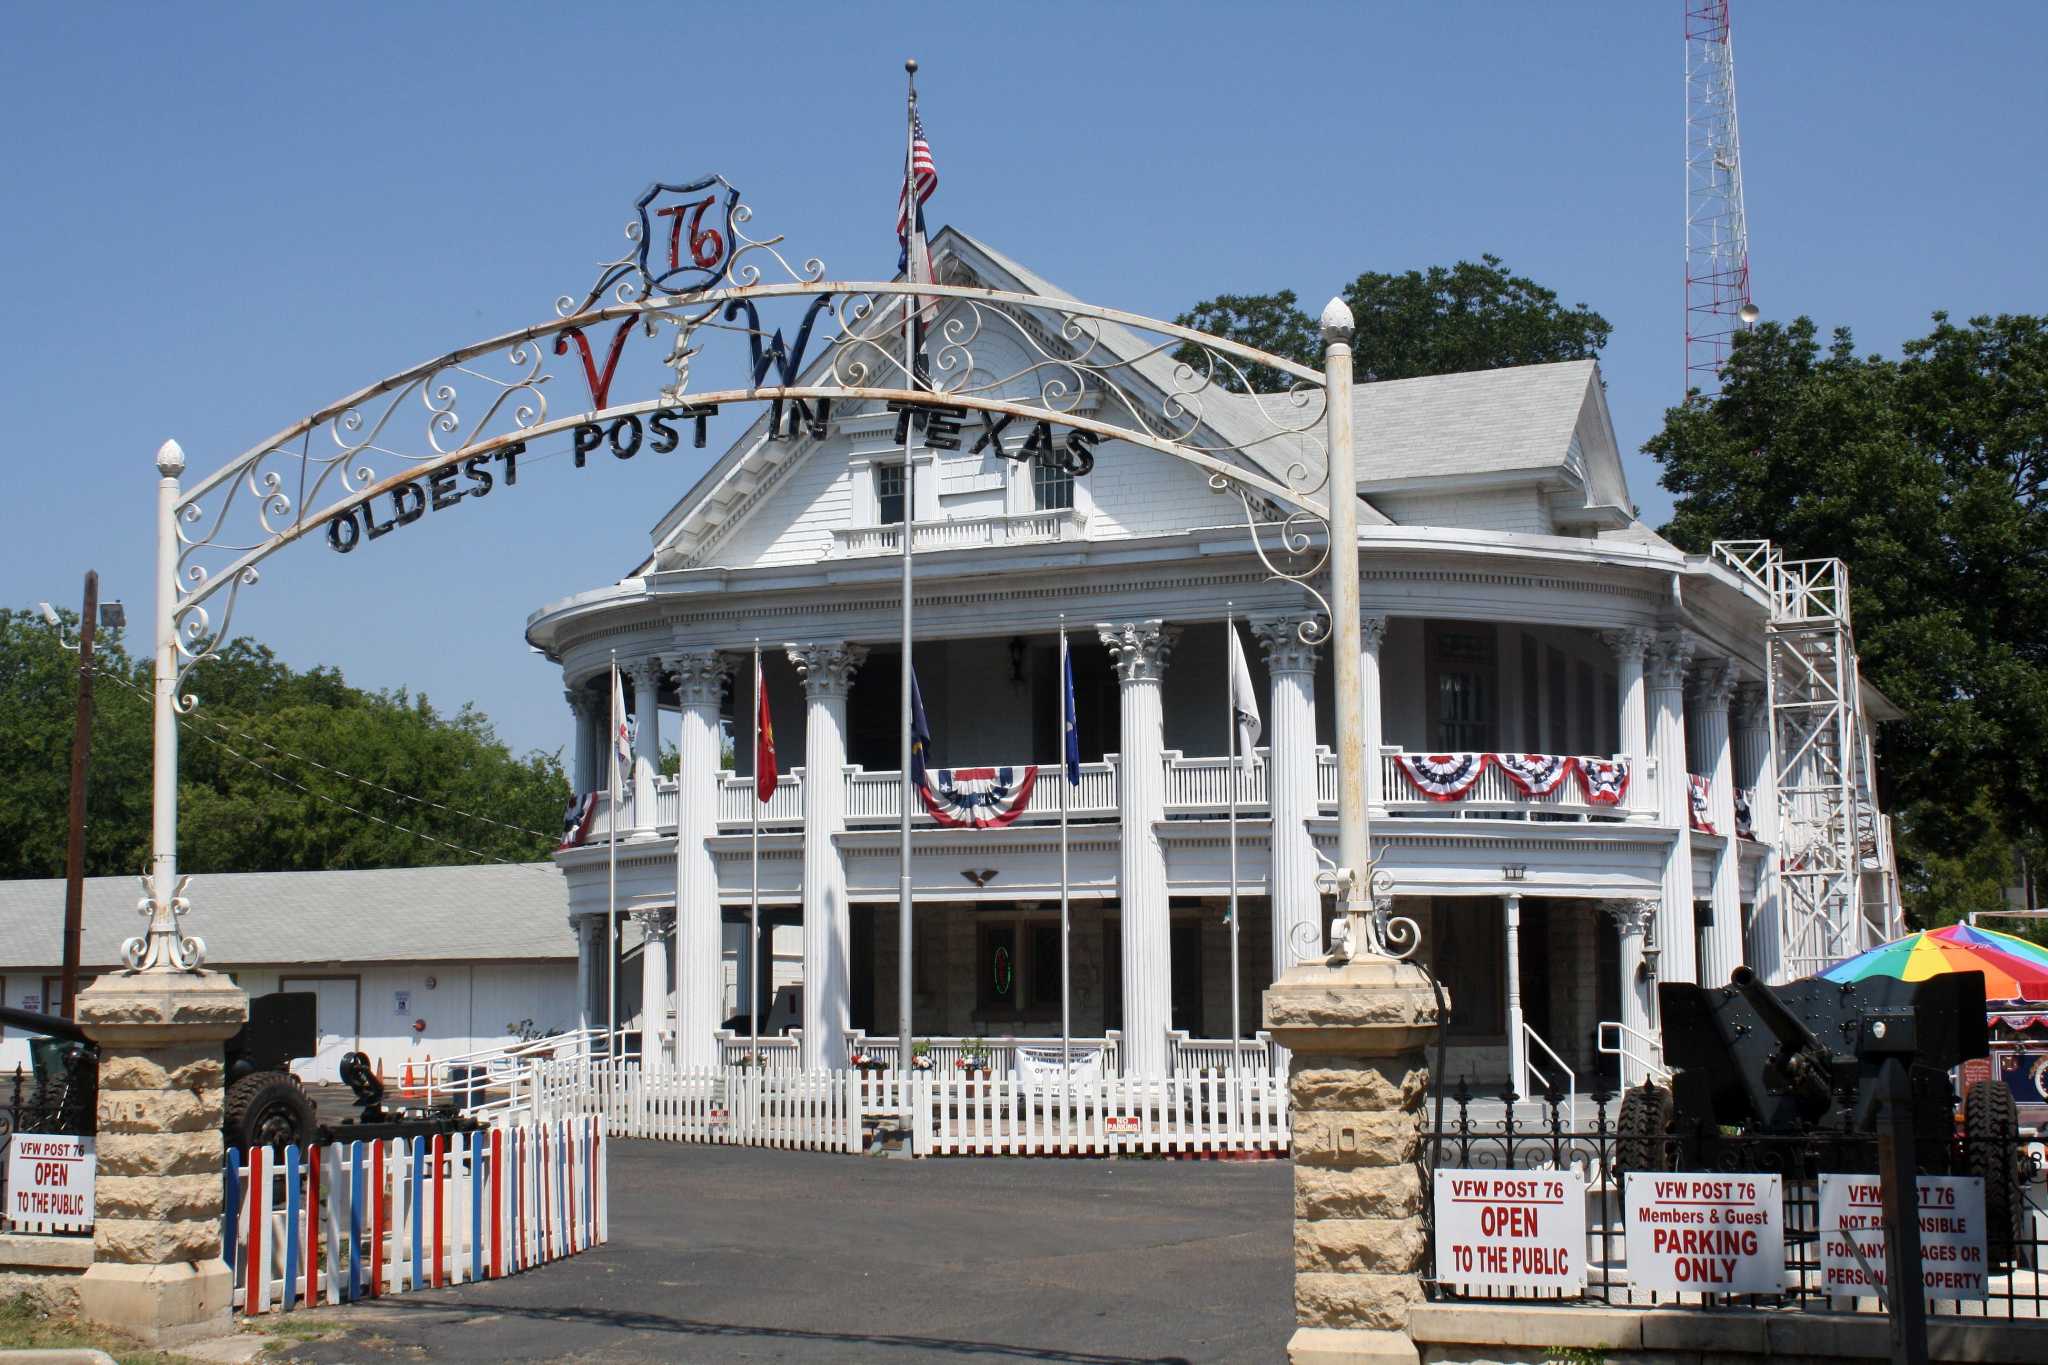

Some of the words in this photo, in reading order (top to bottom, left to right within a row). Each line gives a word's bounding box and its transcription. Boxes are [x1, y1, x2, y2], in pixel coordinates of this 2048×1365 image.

[656, 195, 724, 270] 76
[327, 442, 526, 553] OLDEST
[574, 404, 719, 467] POST
[768, 398, 830, 441] IN
[887, 400, 1100, 476] TEXAS
[20, 1142, 42, 1155] VFW
[44, 1143, 71, 1157] POST
[73, 1144, 85, 1157] 76
[35, 1162, 68, 1186] OPEN
[1452, 1180, 1488, 1197] VFW
[1493, 1181, 1538, 1198] POST
[1543, 1182, 1564, 1199] 76
[1655, 1181, 1688, 1199] VFW
[1692, 1182, 1733, 1200] POST
[1737, 1183, 1756, 1200] 76
[1848, 1185, 1882, 1203] VFW
[1935, 1187, 1955, 1205] 76
[17, 1191, 29, 1213] TO
[31, 1192, 49, 1214] THE
[51, 1193, 84, 1216] PUBLIC
[1481, 1206, 1538, 1237] OPEN
[1639, 1207, 1704, 1224] Members
[1709, 1208, 1720, 1224] &
[1725, 1209, 1768, 1225] Guest
[1839, 1215, 1867, 1231] NOT
[1653, 1229, 1758, 1256] PARKING
[1961, 1247, 1981, 1262] OR
[1452, 1245, 1473, 1273] TO
[1477, 1246, 1508, 1274] THE
[1512, 1247, 1569, 1276] PUBLIC
[1674, 1257, 1737, 1283] ONLY
